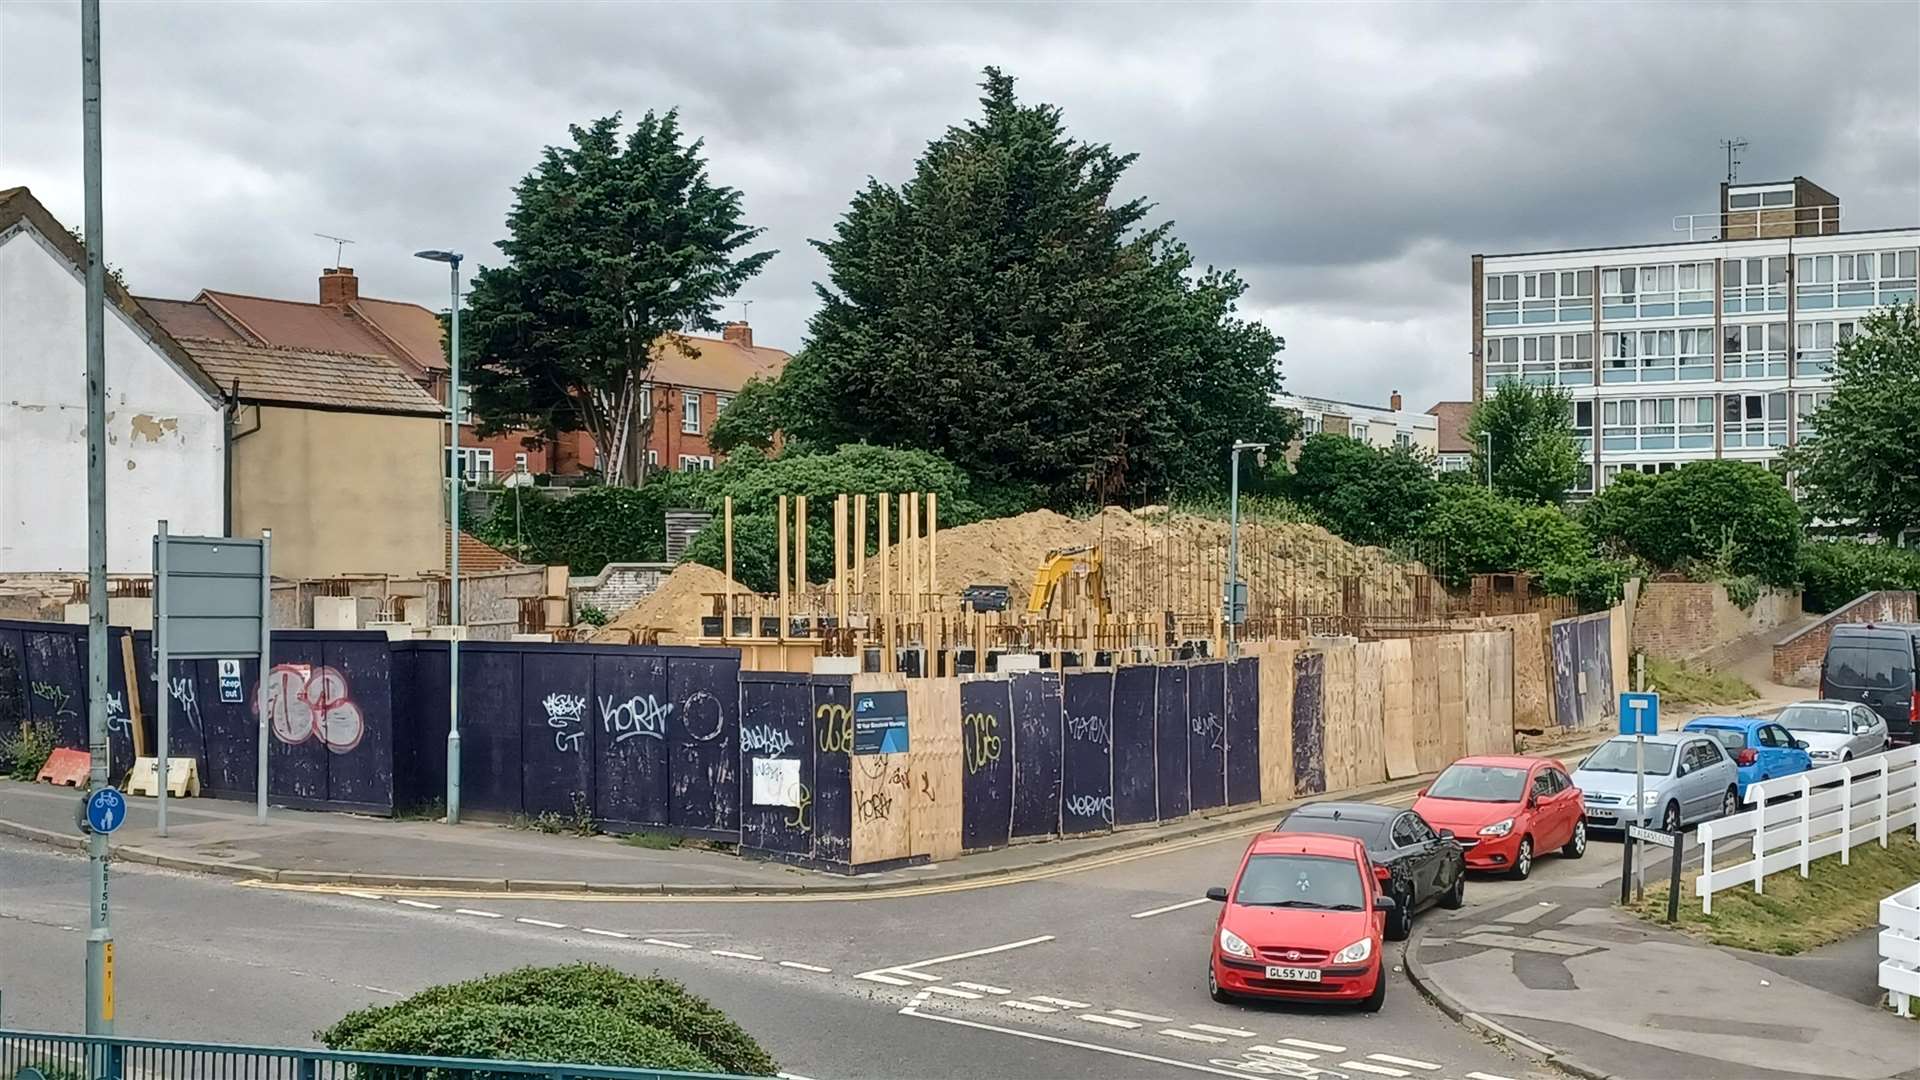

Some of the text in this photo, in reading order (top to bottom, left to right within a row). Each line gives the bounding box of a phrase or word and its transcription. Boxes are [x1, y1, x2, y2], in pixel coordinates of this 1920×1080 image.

[221, 679, 240, 688] Keep
[225, 690, 238, 698] out
[1270, 968, 1295, 978] GL55
